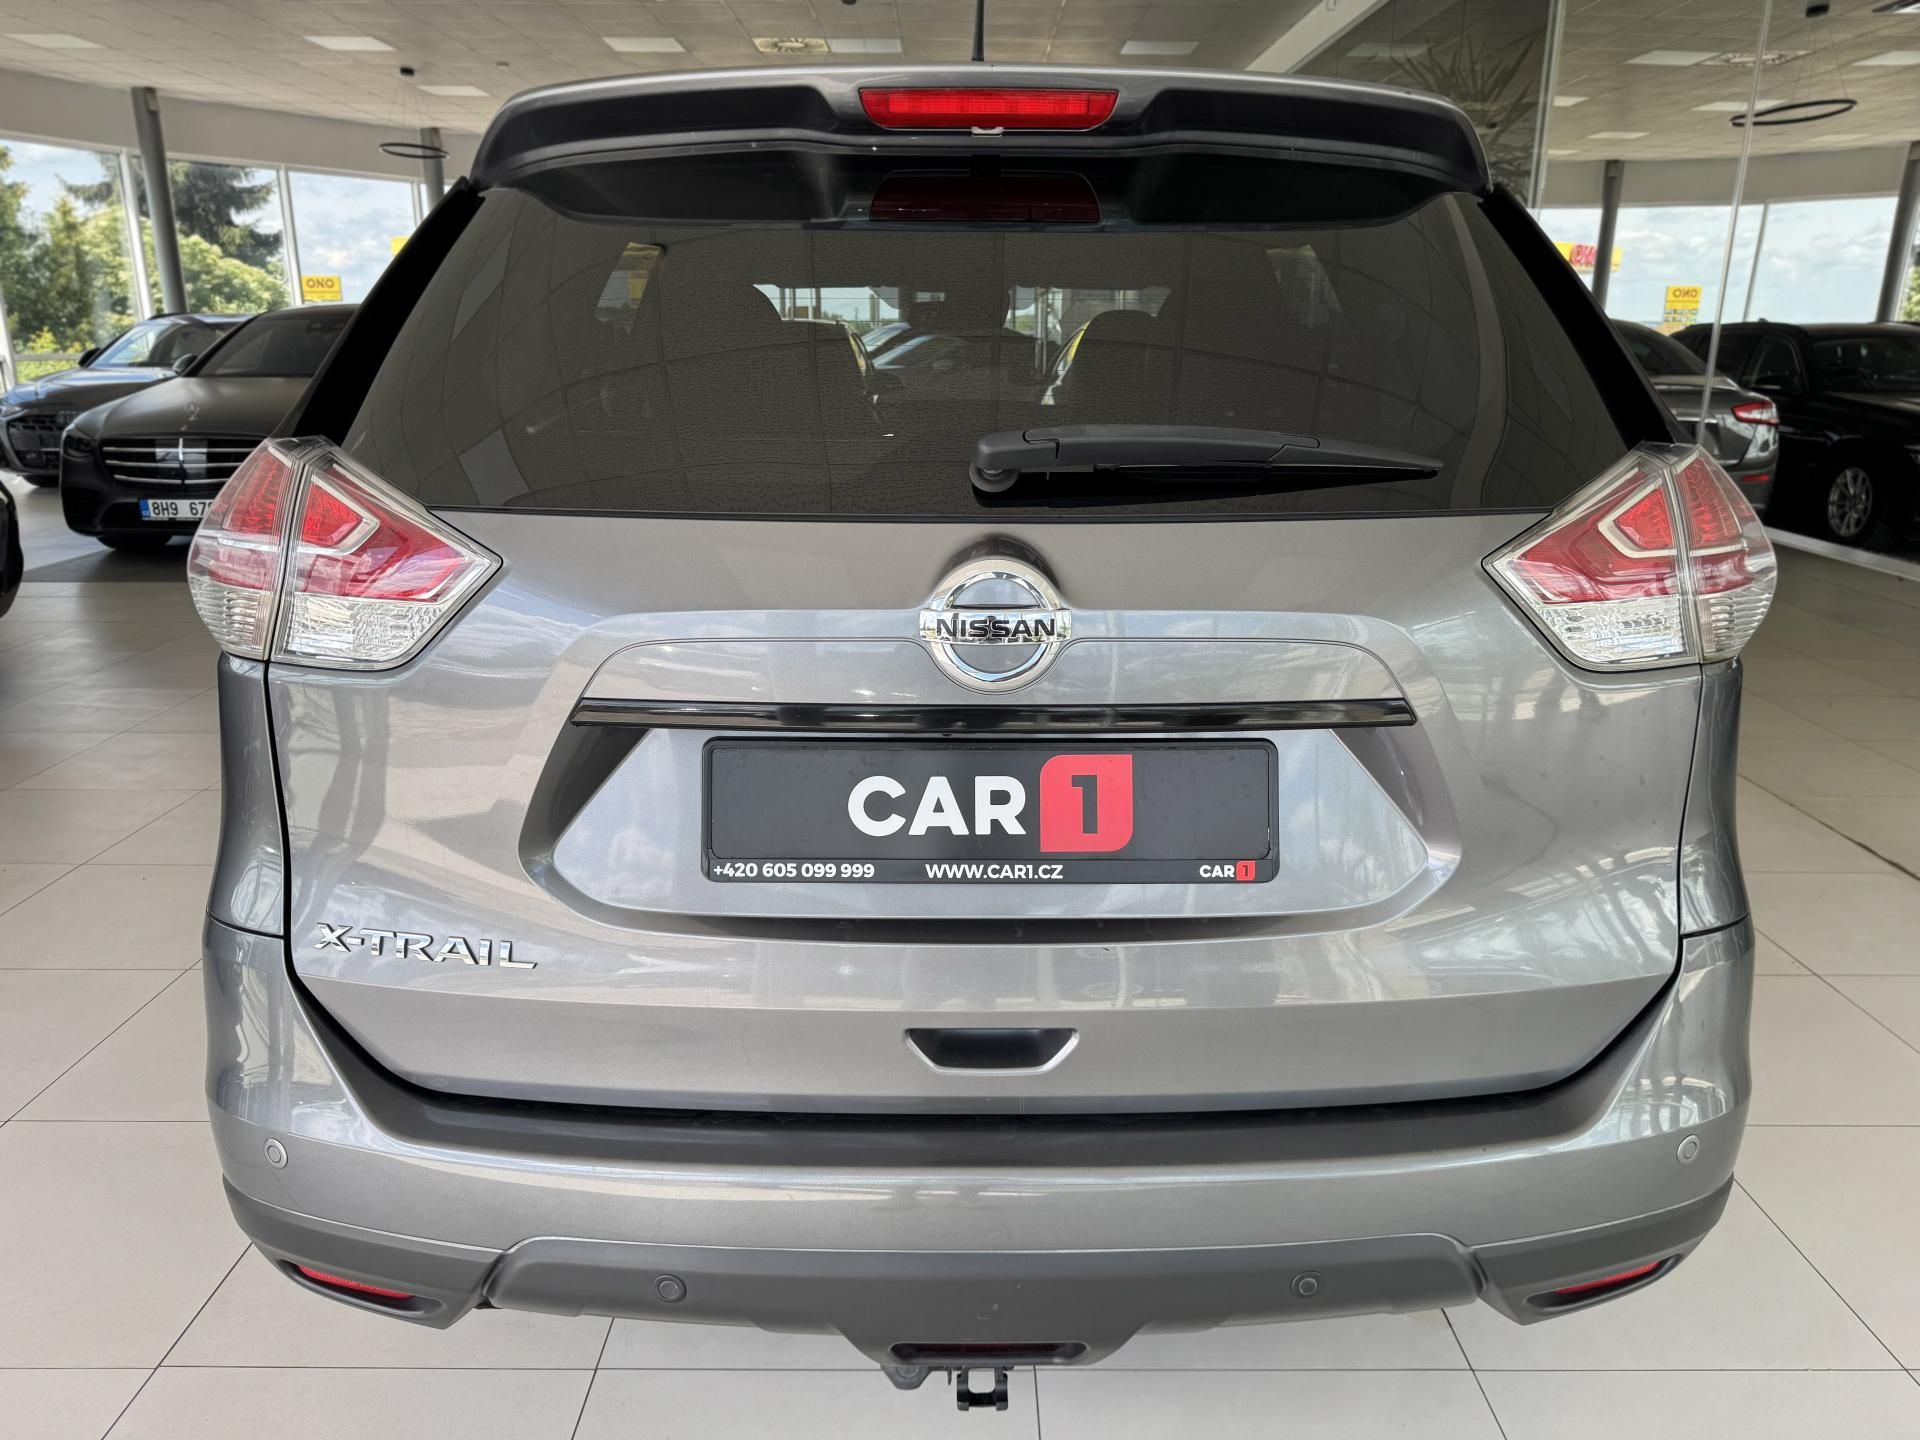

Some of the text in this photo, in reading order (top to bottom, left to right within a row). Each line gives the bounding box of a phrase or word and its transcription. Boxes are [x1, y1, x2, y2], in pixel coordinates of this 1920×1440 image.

[306, 278, 335, 288] ONO
[151, 501, 179, 516] 8H9
[936, 618, 1055, 638] NISSAN
[847, 775, 1026, 837] CAR
[714, 862, 875, 878] +420 605 099 999
[925, 864, 1063, 879] WWW.CAR1.CZ
[313, 922, 538, 970] X-TRAIL
